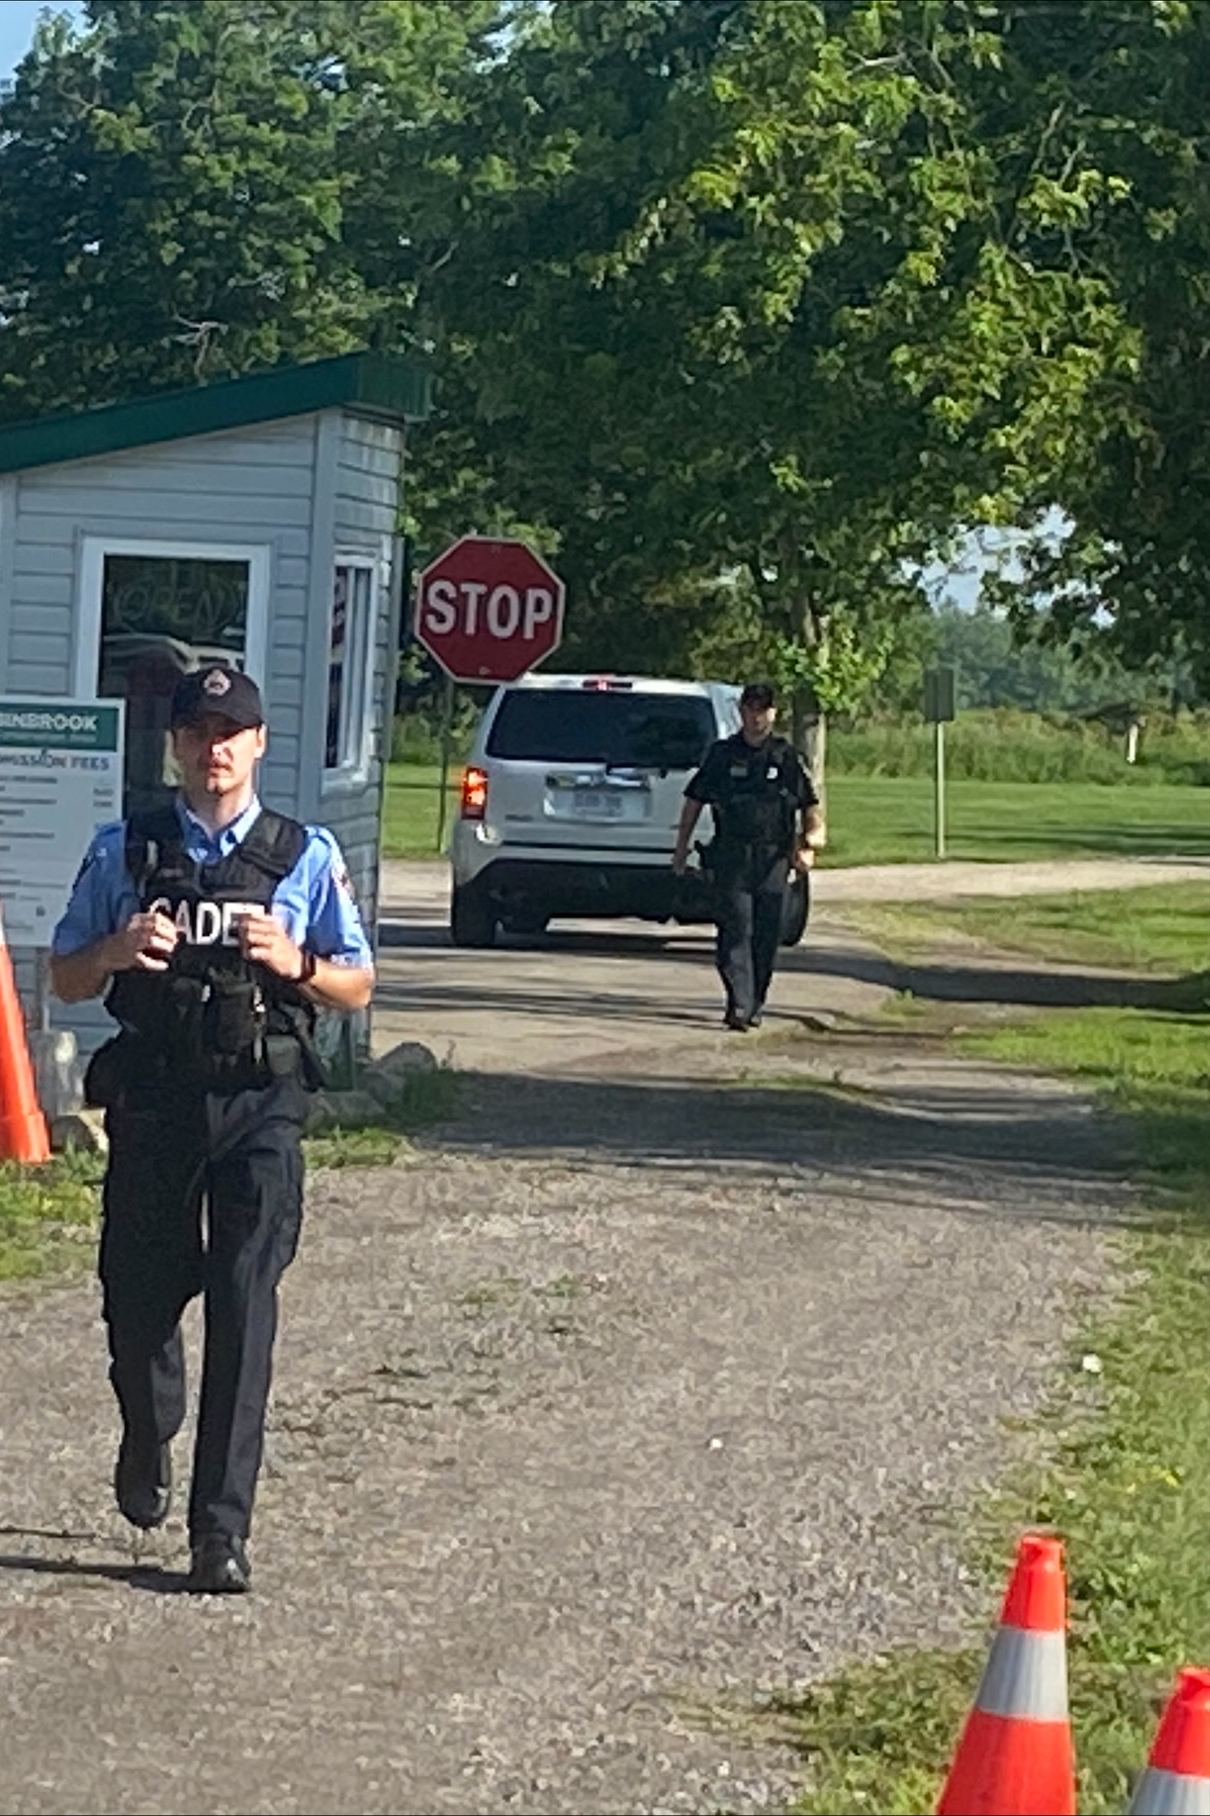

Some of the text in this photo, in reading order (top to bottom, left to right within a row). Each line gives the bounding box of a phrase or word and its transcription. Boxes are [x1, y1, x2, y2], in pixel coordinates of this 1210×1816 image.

[425, 579, 553, 640] STOP
[71, 755, 111, 771] FEES
[150, 897, 265, 945] ADE
